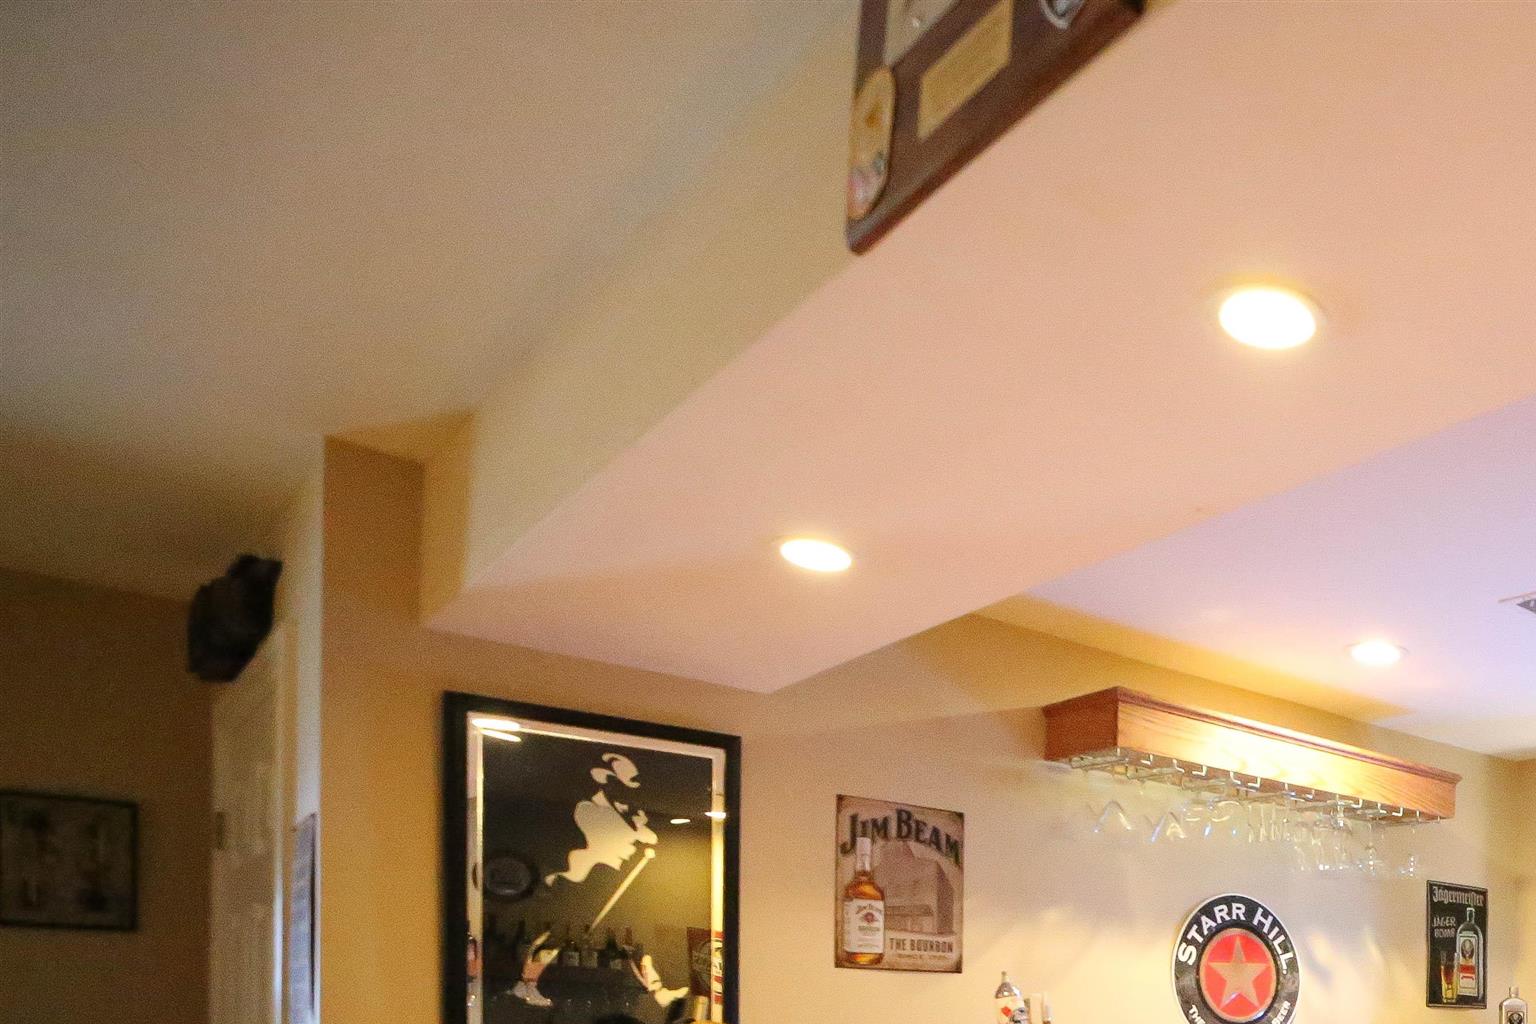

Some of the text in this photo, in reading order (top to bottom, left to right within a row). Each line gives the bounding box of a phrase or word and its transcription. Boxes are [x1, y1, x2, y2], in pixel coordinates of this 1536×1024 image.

[840, 809, 961, 867] JIM BEAM
[889, 938, 906, 951] THE
[1178, 902, 1246, 966] STARR
